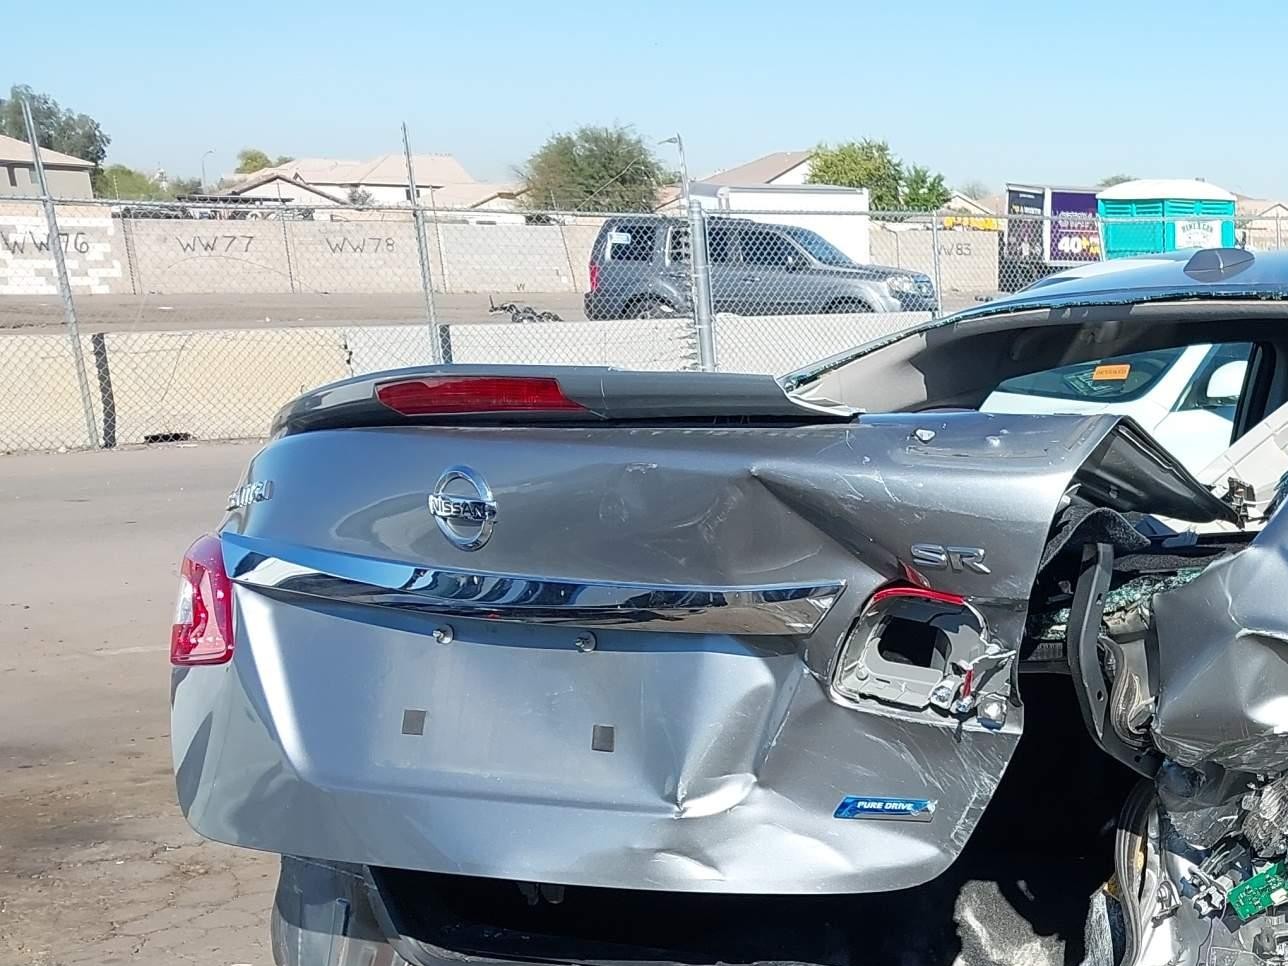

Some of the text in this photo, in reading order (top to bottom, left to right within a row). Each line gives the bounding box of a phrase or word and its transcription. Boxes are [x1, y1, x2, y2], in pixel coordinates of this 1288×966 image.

[432, 497, 486, 520] NISSAN
[910, 543, 992, 575] SR
[857, 801, 914, 811] PURE DRIVE
